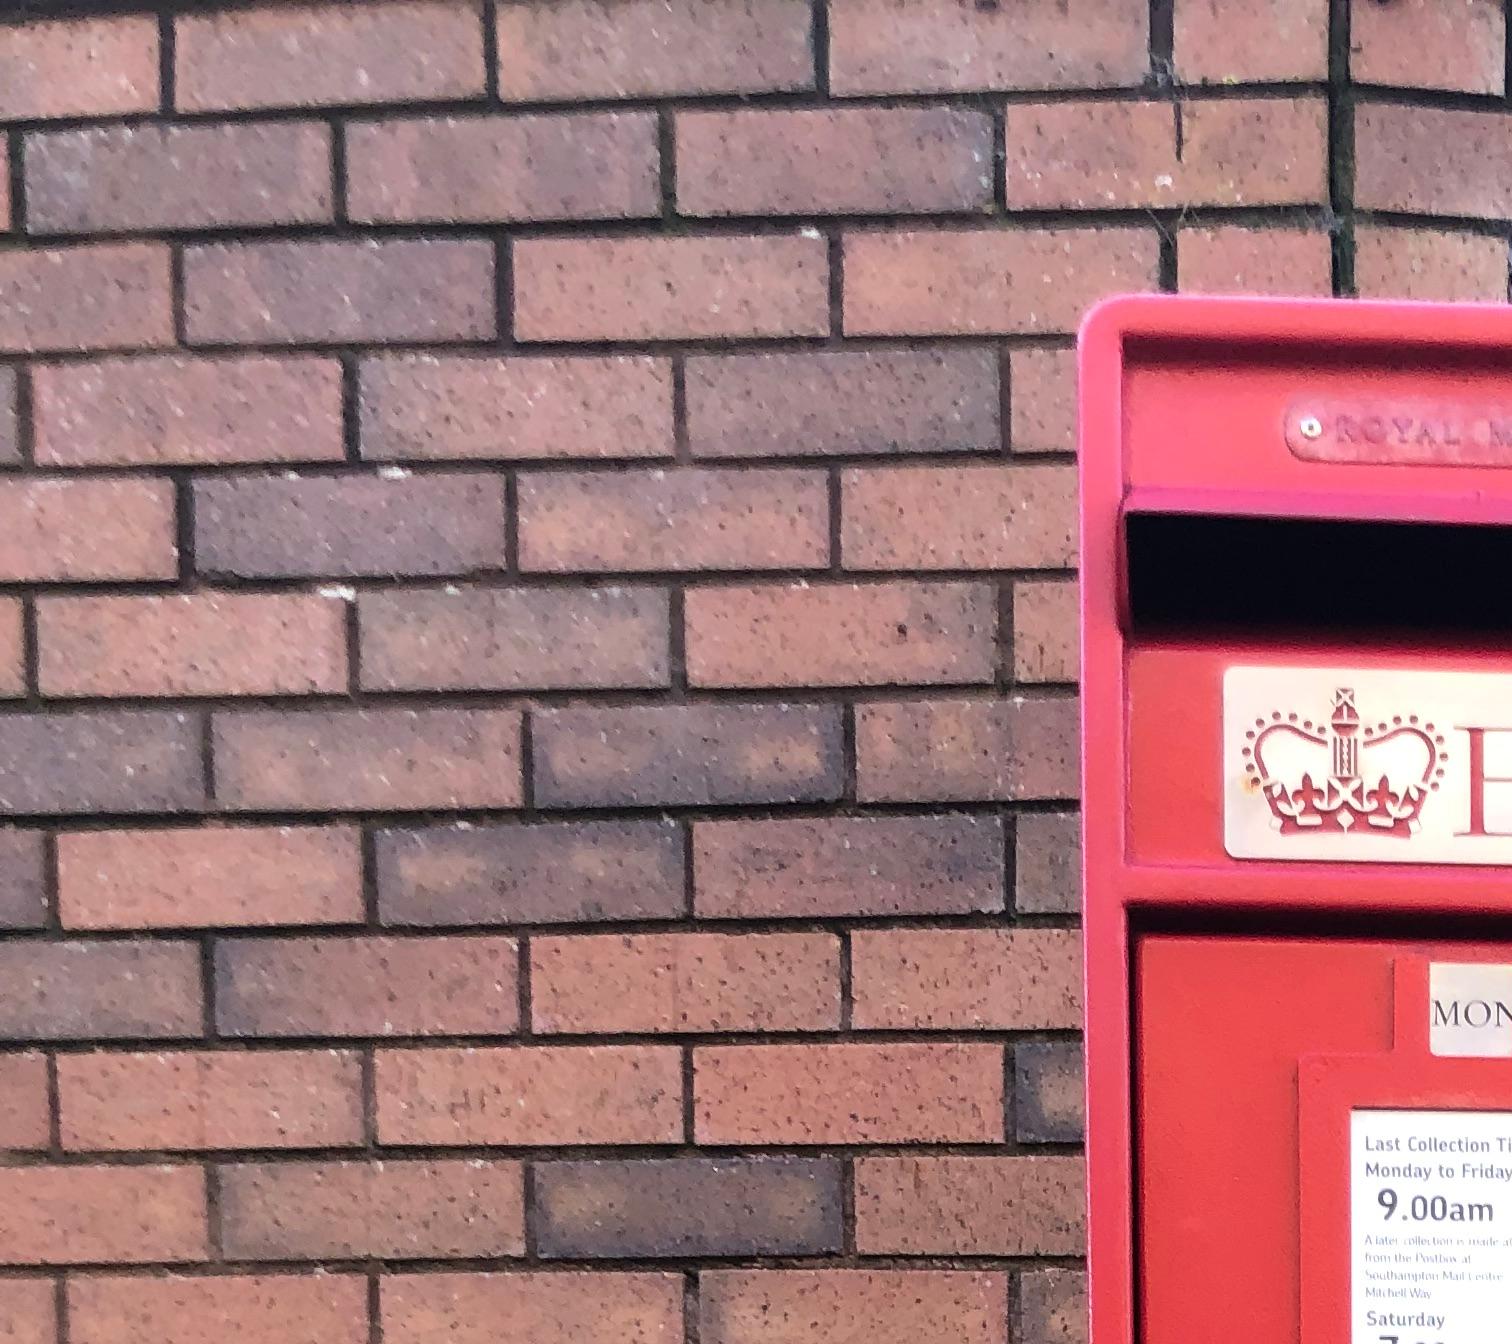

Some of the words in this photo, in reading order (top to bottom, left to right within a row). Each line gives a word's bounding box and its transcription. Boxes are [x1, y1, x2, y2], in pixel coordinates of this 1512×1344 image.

[1334, 414, 1461, 446] ROYAL
[1365, 1135, 1401, 1153] Last
[1407, 1135, 1491, 1154] Collection
[1365, 1161, 1433, 1183] Monday
[1437, 1163, 1455, 1179] to
[1377, 1187, 1494, 1223] 9.00am
[1364, 1251, 1391, 1264] from
[1394, 1252, 1412, 1264] the
[1415, 1252, 1457, 1264] Postbox
[1364, 1269, 1439, 1283] Southampton
[1442, 1270, 1465, 1281] Mail
[1365, 1286, 1408, 1299] Mitchell
[1408, 1287, 1432, 1300] Way
[1366, 1309, 1446, 1331] Saturday
